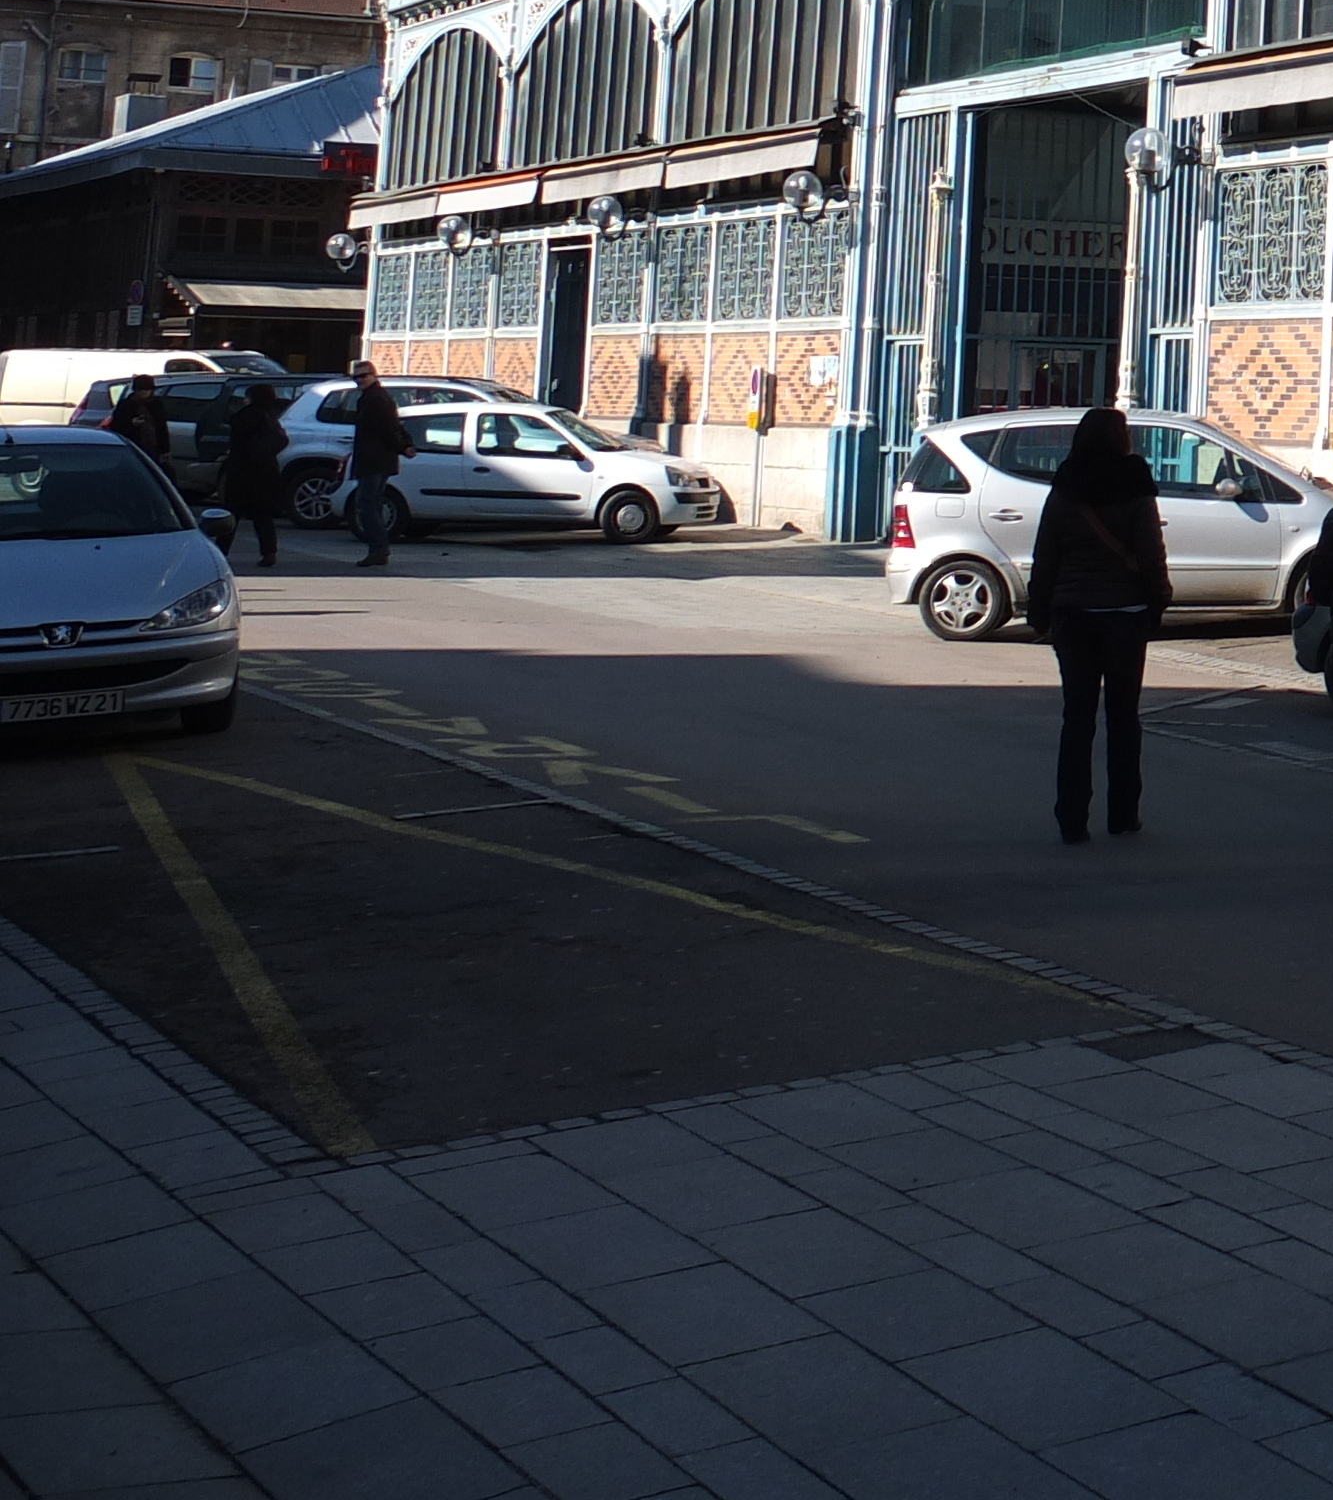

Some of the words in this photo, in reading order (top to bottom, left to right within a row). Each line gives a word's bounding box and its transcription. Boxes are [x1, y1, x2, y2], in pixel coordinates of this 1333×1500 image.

[9, 698, 62, 720] 7736
[66, 695, 90, 715] WZ
[95, 693, 118, 712] 21
